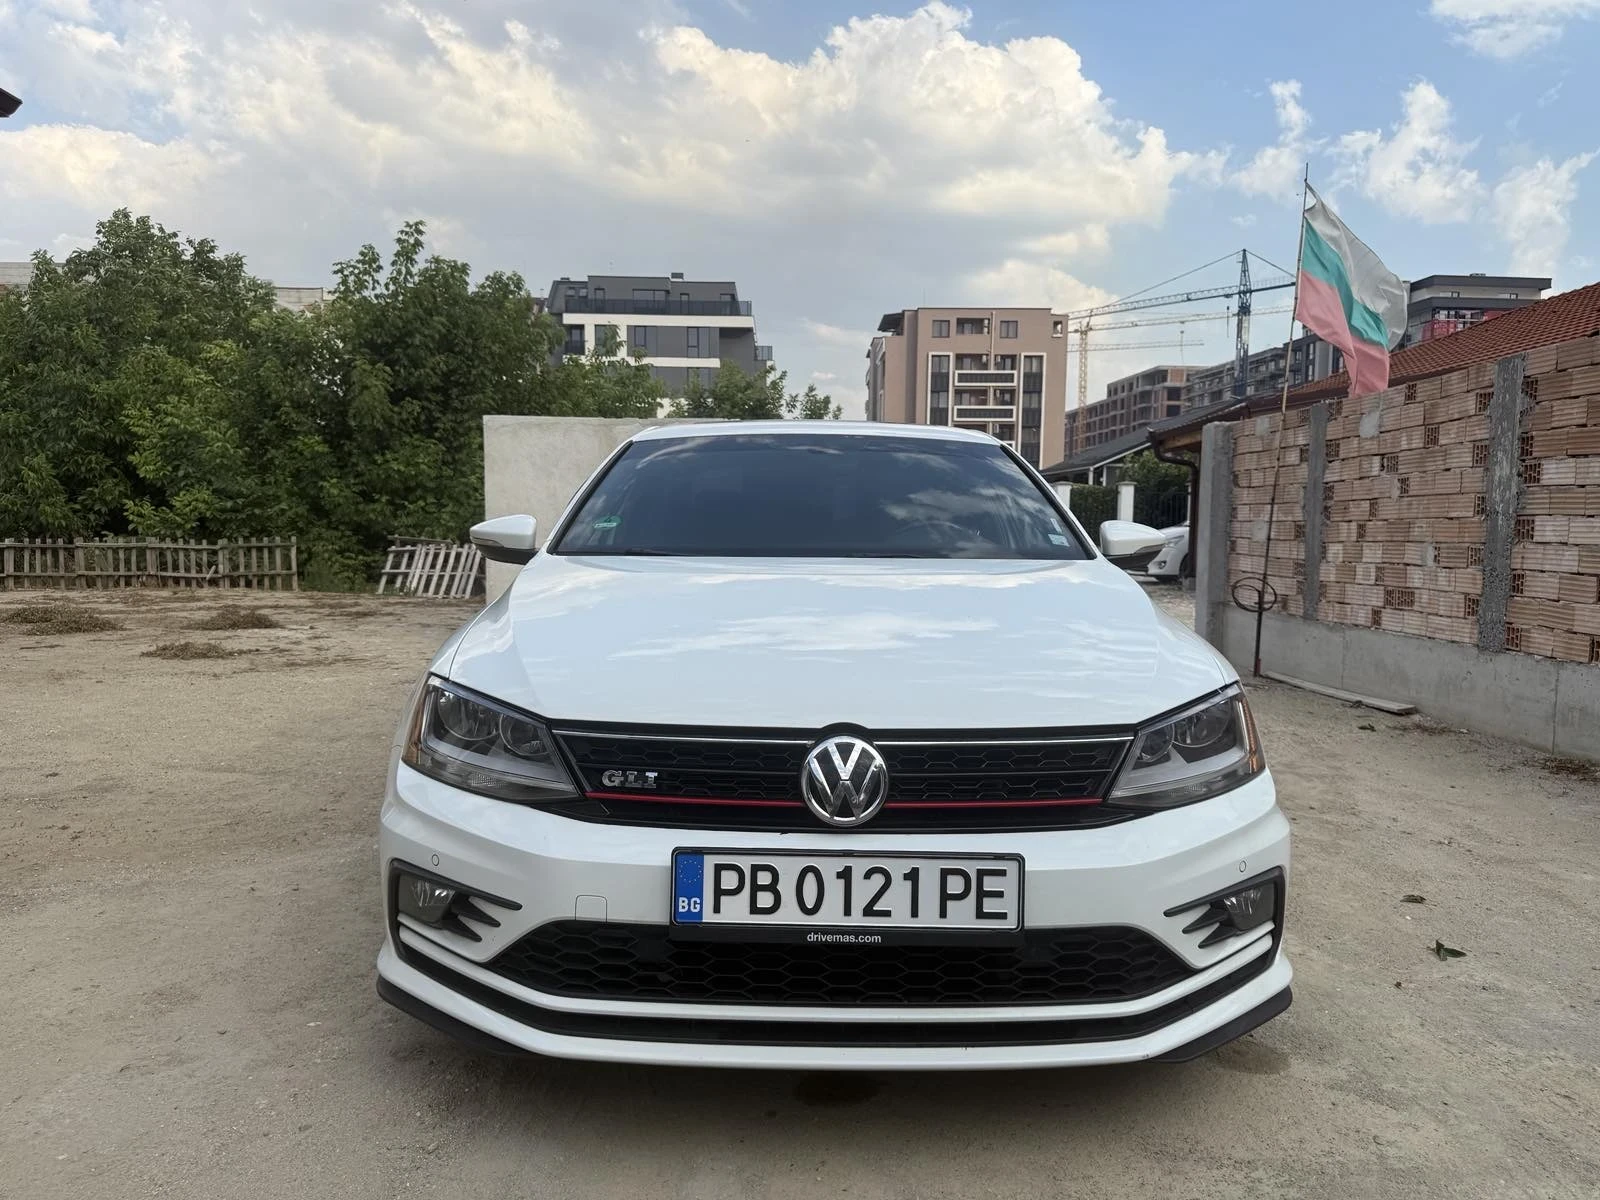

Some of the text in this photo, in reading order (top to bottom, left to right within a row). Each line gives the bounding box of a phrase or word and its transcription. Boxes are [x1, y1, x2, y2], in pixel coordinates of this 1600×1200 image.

[602, 769, 658, 789] GLI
[808, 739, 884, 820] VW
[713, 863, 1008, 920] PB 0121 PE
[678, 897, 700, 913] BG
[807, 932, 882, 943] drivemas.com
